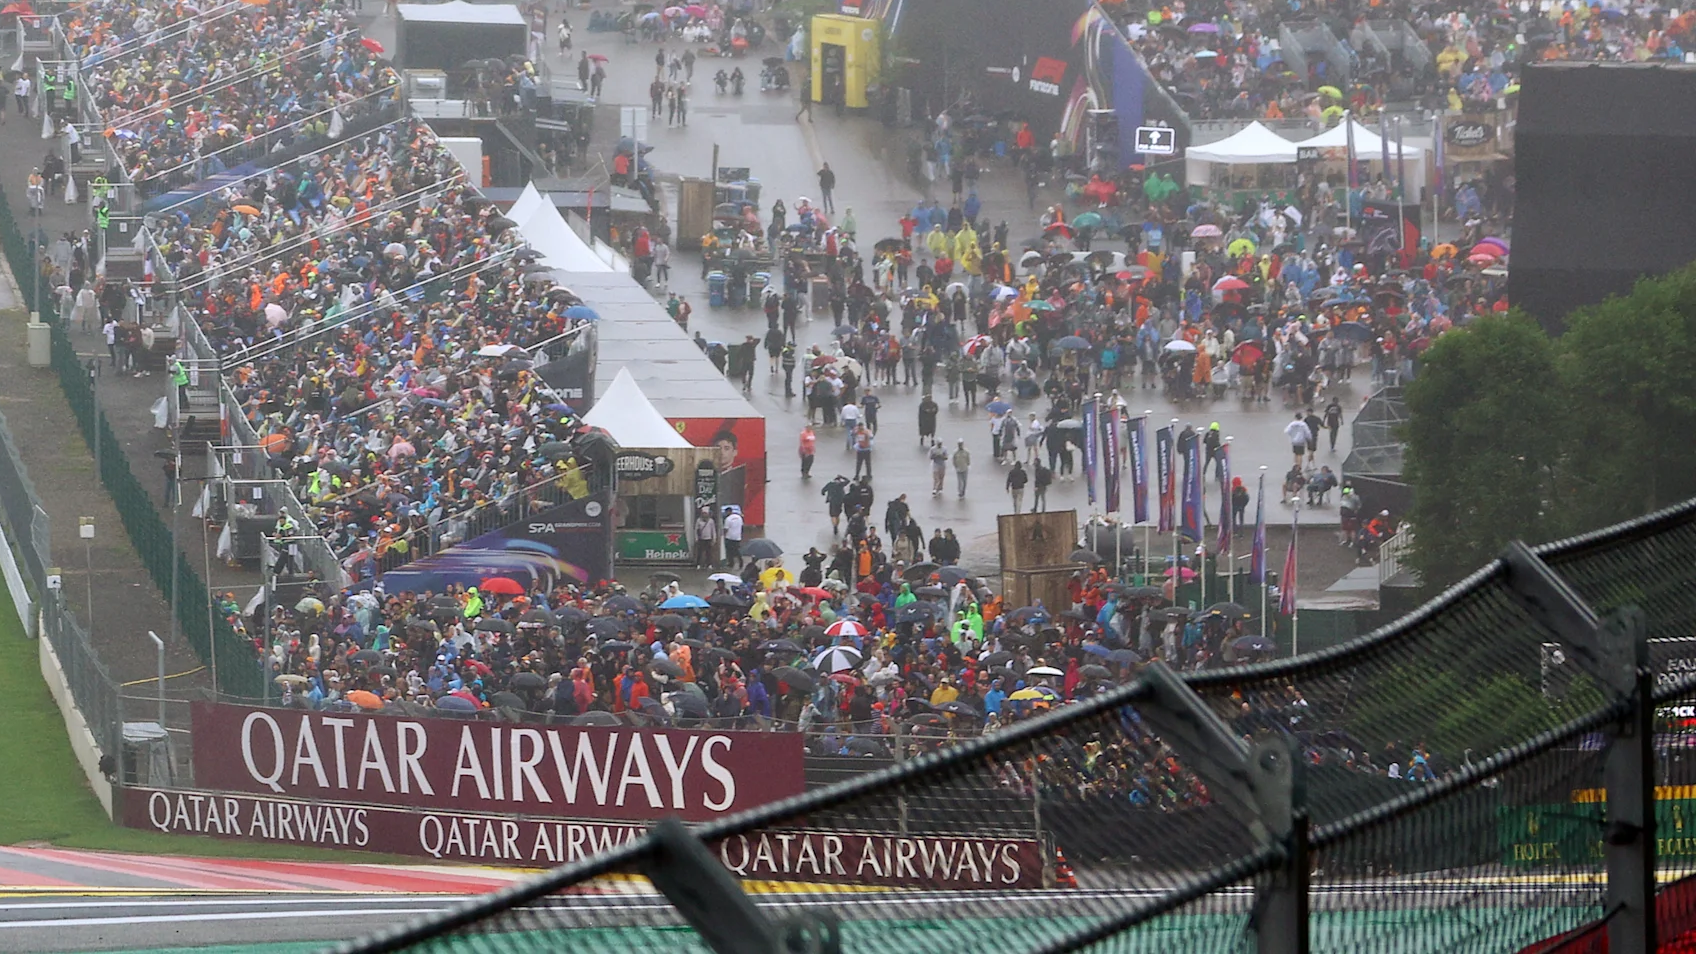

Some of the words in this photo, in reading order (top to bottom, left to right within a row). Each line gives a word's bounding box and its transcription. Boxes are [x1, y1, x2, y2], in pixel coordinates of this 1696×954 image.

[1454, 124, 1485, 140] Tickets
[1299, 148, 1319, 159] BAR
[617, 456, 654, 471] EERHOUSE
[645, 549, 690, 560] Heinek
[241, 711, 434, 793] QATAR
[451, 724, 736, 812] AIRWAYS
[149, 791, 242, 836] QATAR
[249, 801, 369, 846] AIRWAYS
[419, 815, 524, 860] QATAR
[532, 823, 648, 863] AIRWA
[720, 833, 847, 877] QATAR
[857, 837, 1021, 884] AIRWAYS
